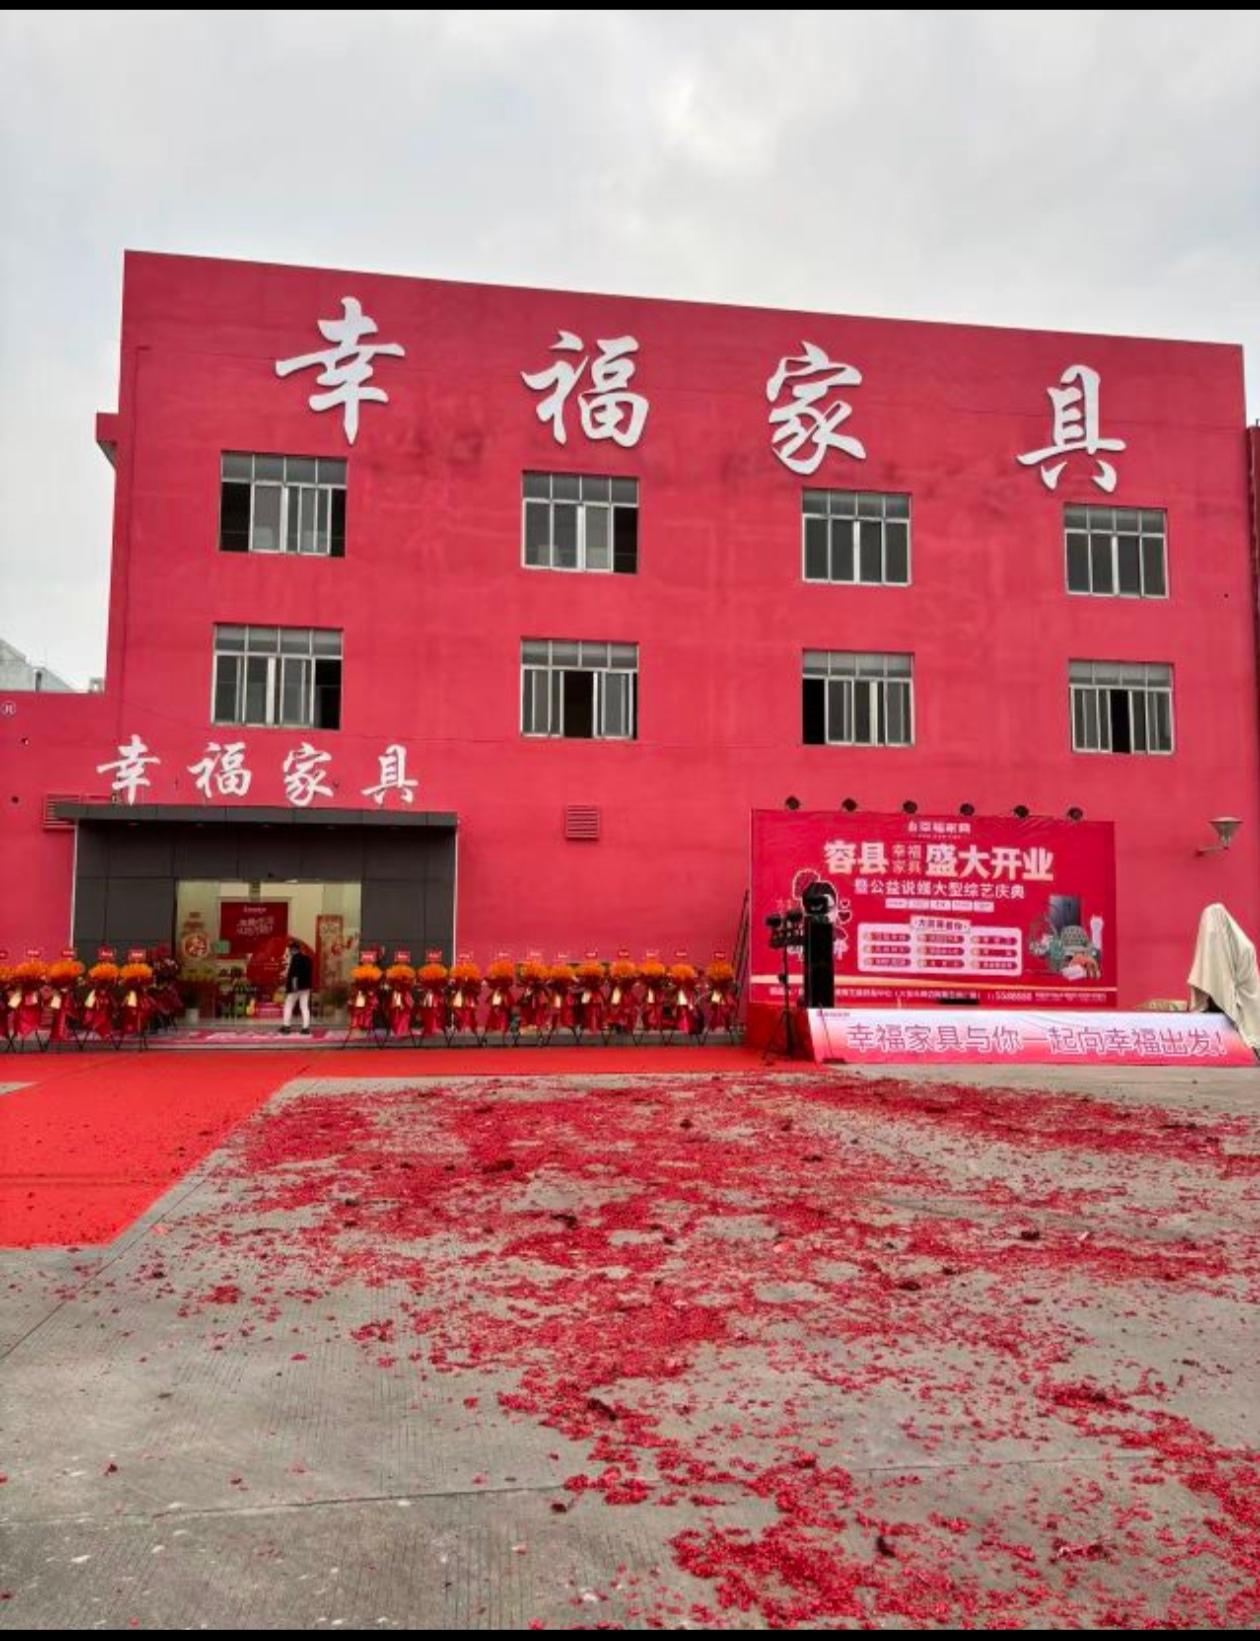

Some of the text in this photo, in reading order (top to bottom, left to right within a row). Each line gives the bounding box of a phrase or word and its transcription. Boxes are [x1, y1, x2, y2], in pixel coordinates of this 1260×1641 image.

[275, 296, 1127, 492] 幸福家具
[96, 734, 419, 807] 幸福家具
[824, 840, 889, 875] 容县
[925, 843, 1054, 881] 盛大开业
